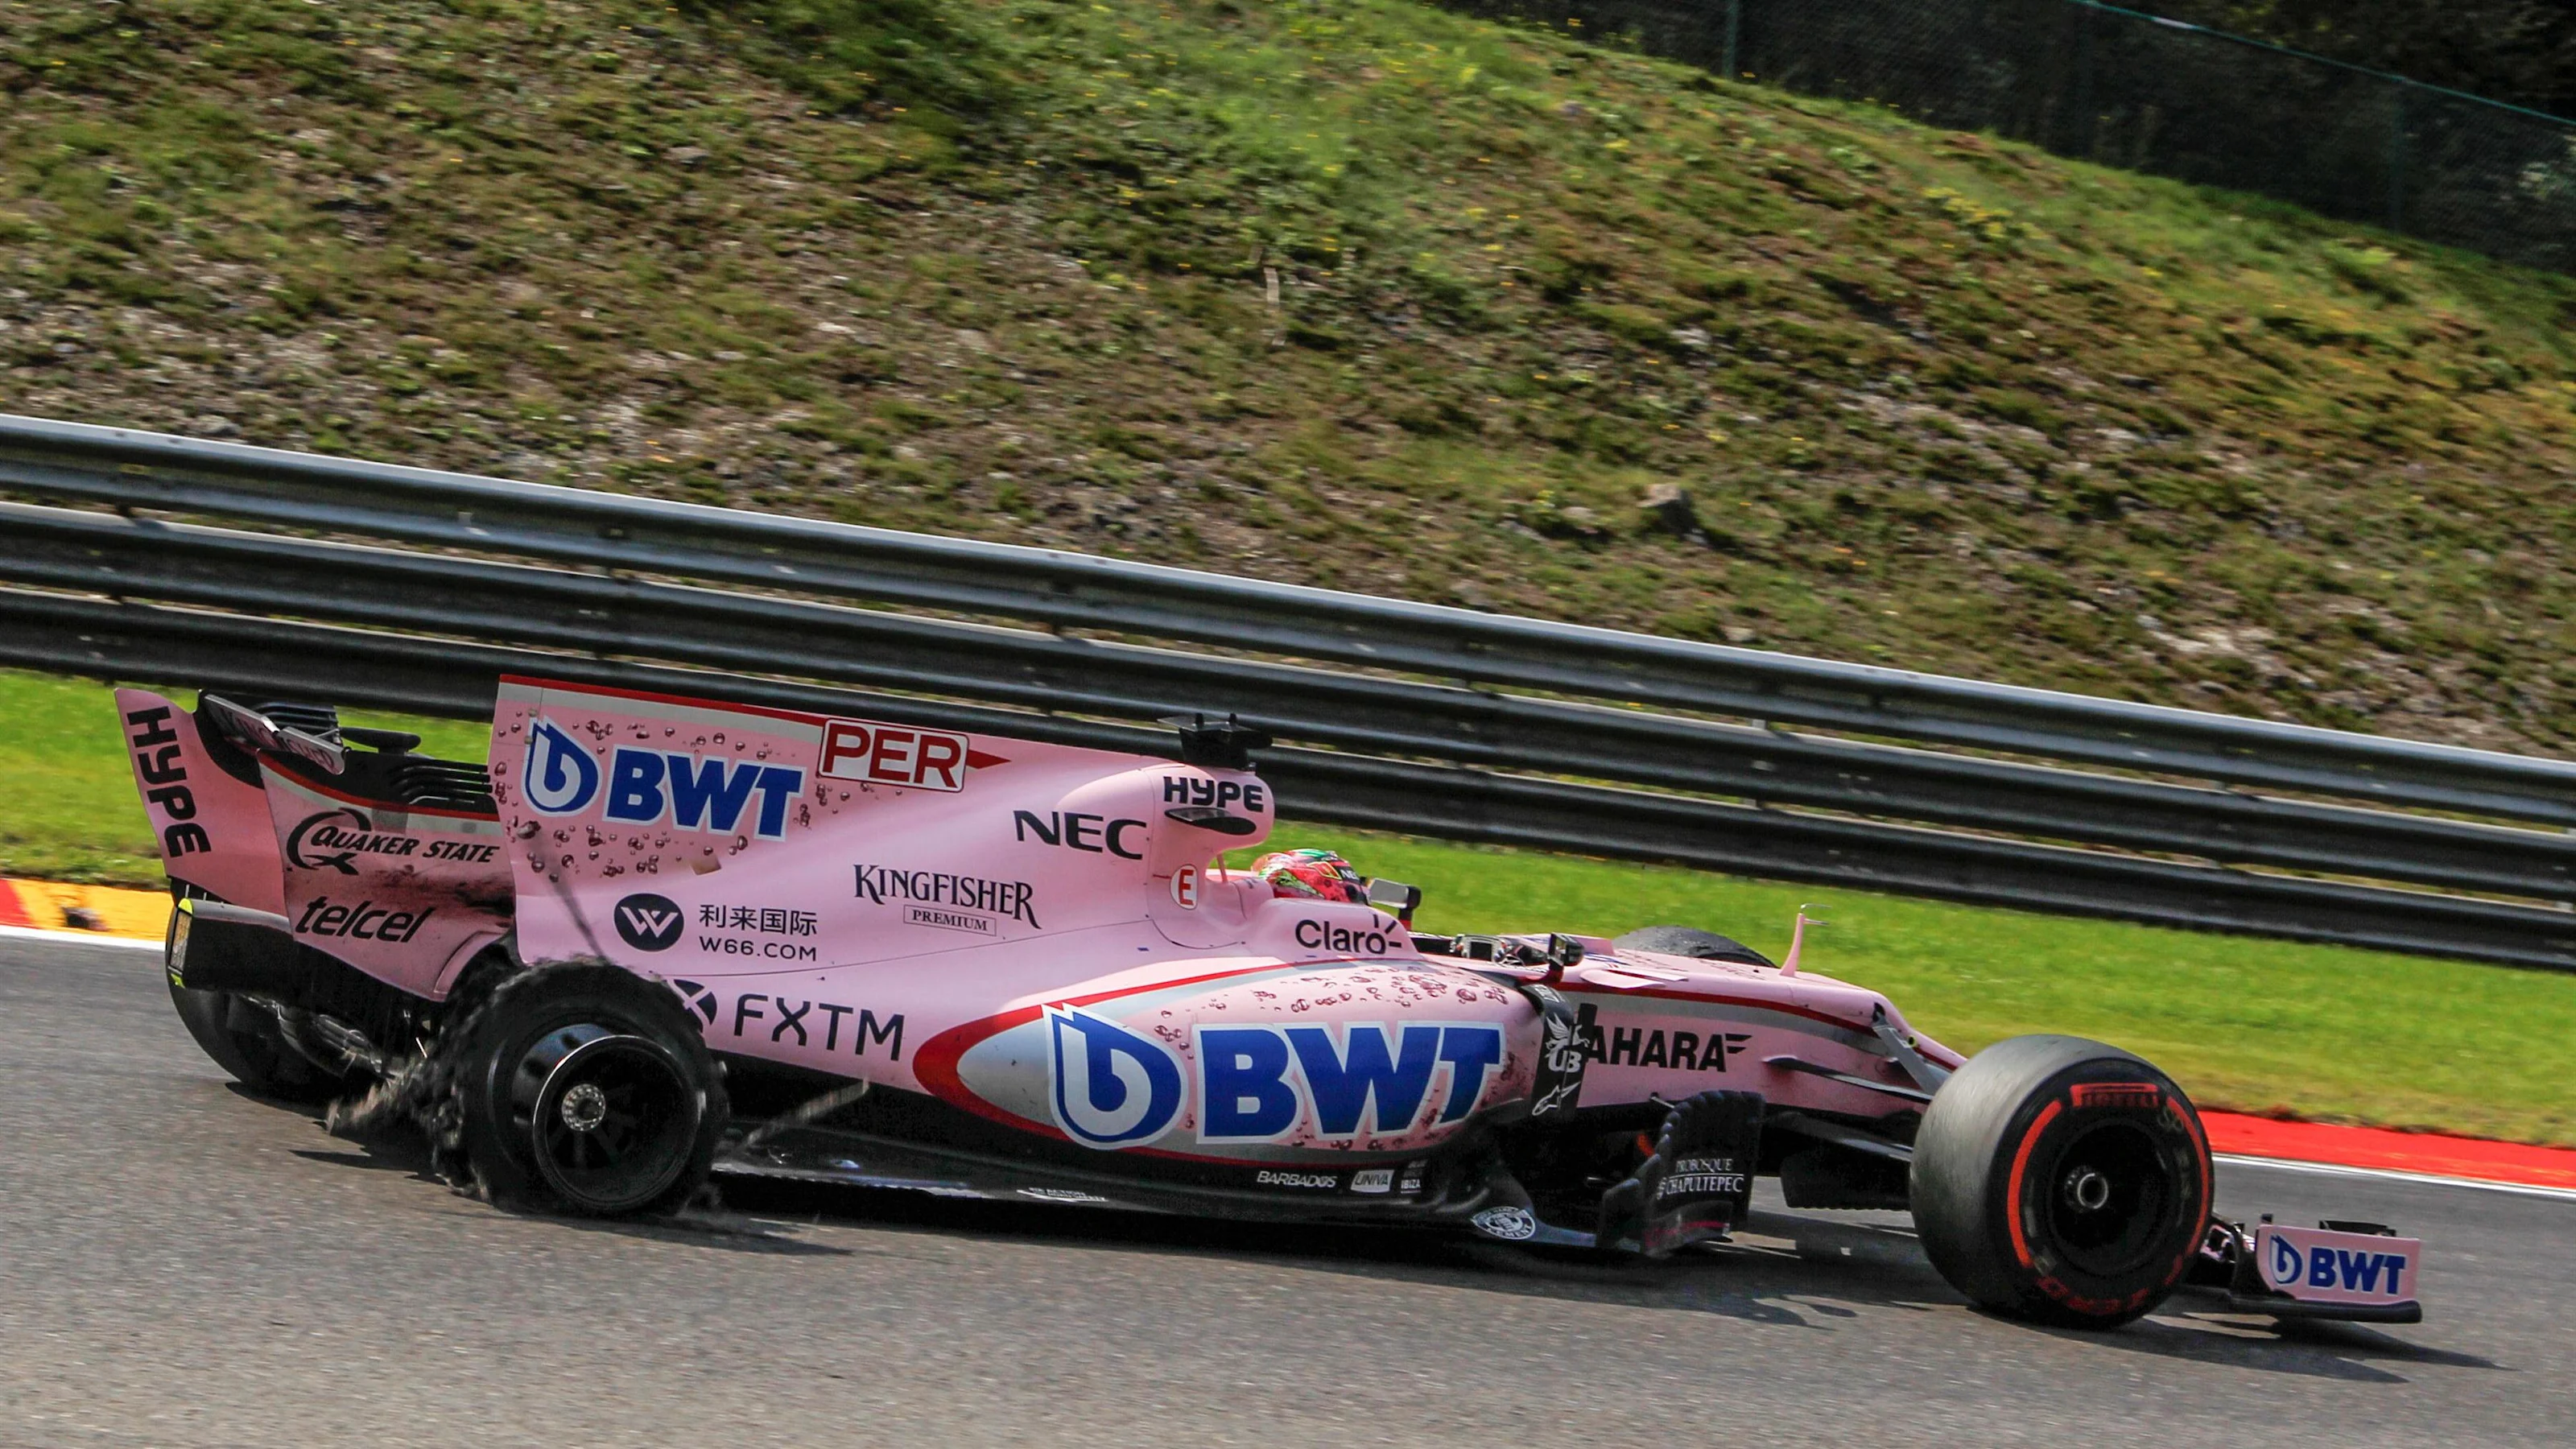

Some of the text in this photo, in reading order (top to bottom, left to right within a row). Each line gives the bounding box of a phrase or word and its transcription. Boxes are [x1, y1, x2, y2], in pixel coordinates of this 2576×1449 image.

[822, 724, 962, 788] PER
[126, 706, 212, 857] HYPE
[603, 745, 806, 840] BWT
[1163, 776, 1264, 813] HYPE
[311, 826, 500, 863] QUAKER STATE
[1013, 810, 1147, 860] NEC
[853, 864, 1041, 929] KINGFISHER
[1178, 869, 1195, 906] E
[295, 896, 436, 943] telcel
[699, 904, 818, 936] 利来国际
[912, 909, 988, 931] PREMIUM
[1295, 919, 1386, 955] Claro
[699, 936, 818, 962] W66.COM
[733, 993, 905, 1060] FXTM
[1582, 1024, 1727, 1072] AHARA
[1199, 1026, 1500, 1137] BWT
[1257, 1170, 1337, 1187] BARBADOS
[2308, 1247, 2406, 1295] BWT
